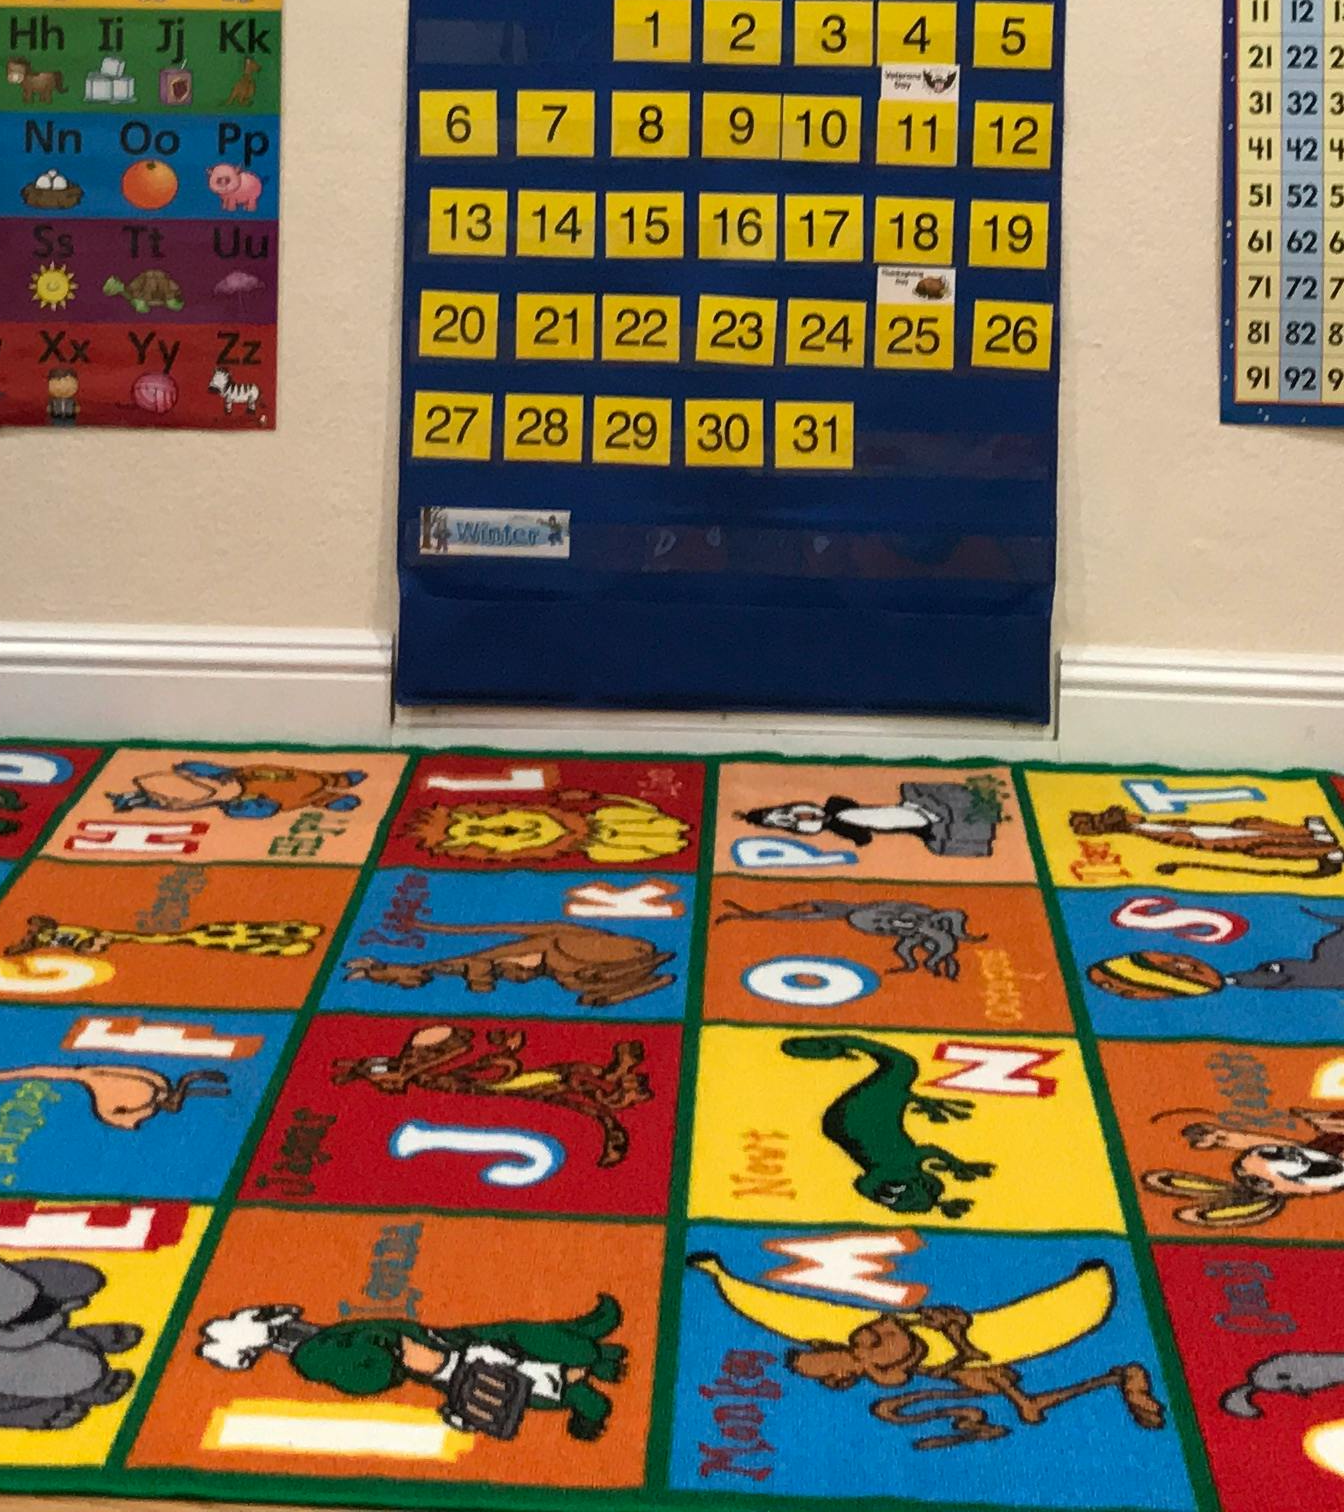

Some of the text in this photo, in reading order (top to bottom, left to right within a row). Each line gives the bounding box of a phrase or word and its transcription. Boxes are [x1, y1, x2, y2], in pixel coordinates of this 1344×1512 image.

[25, 120, 82, 153] Nn
[119, 121, 180, 155] Oo
[218, 122, 269, 162] Pp
[425, 405, 838, 454] 27 28 29 30 31
[454, 520, 540, 547] Winter
[563, 880, 689, 919] K
[928, 1039, 1064, 1099] N
[388, 1119, 566, 1189] J
[731, 1128, 798, 1201] Newt
[760, 1230, 930, 1308] M
[698, 1346, 788, 1482] Monkey
